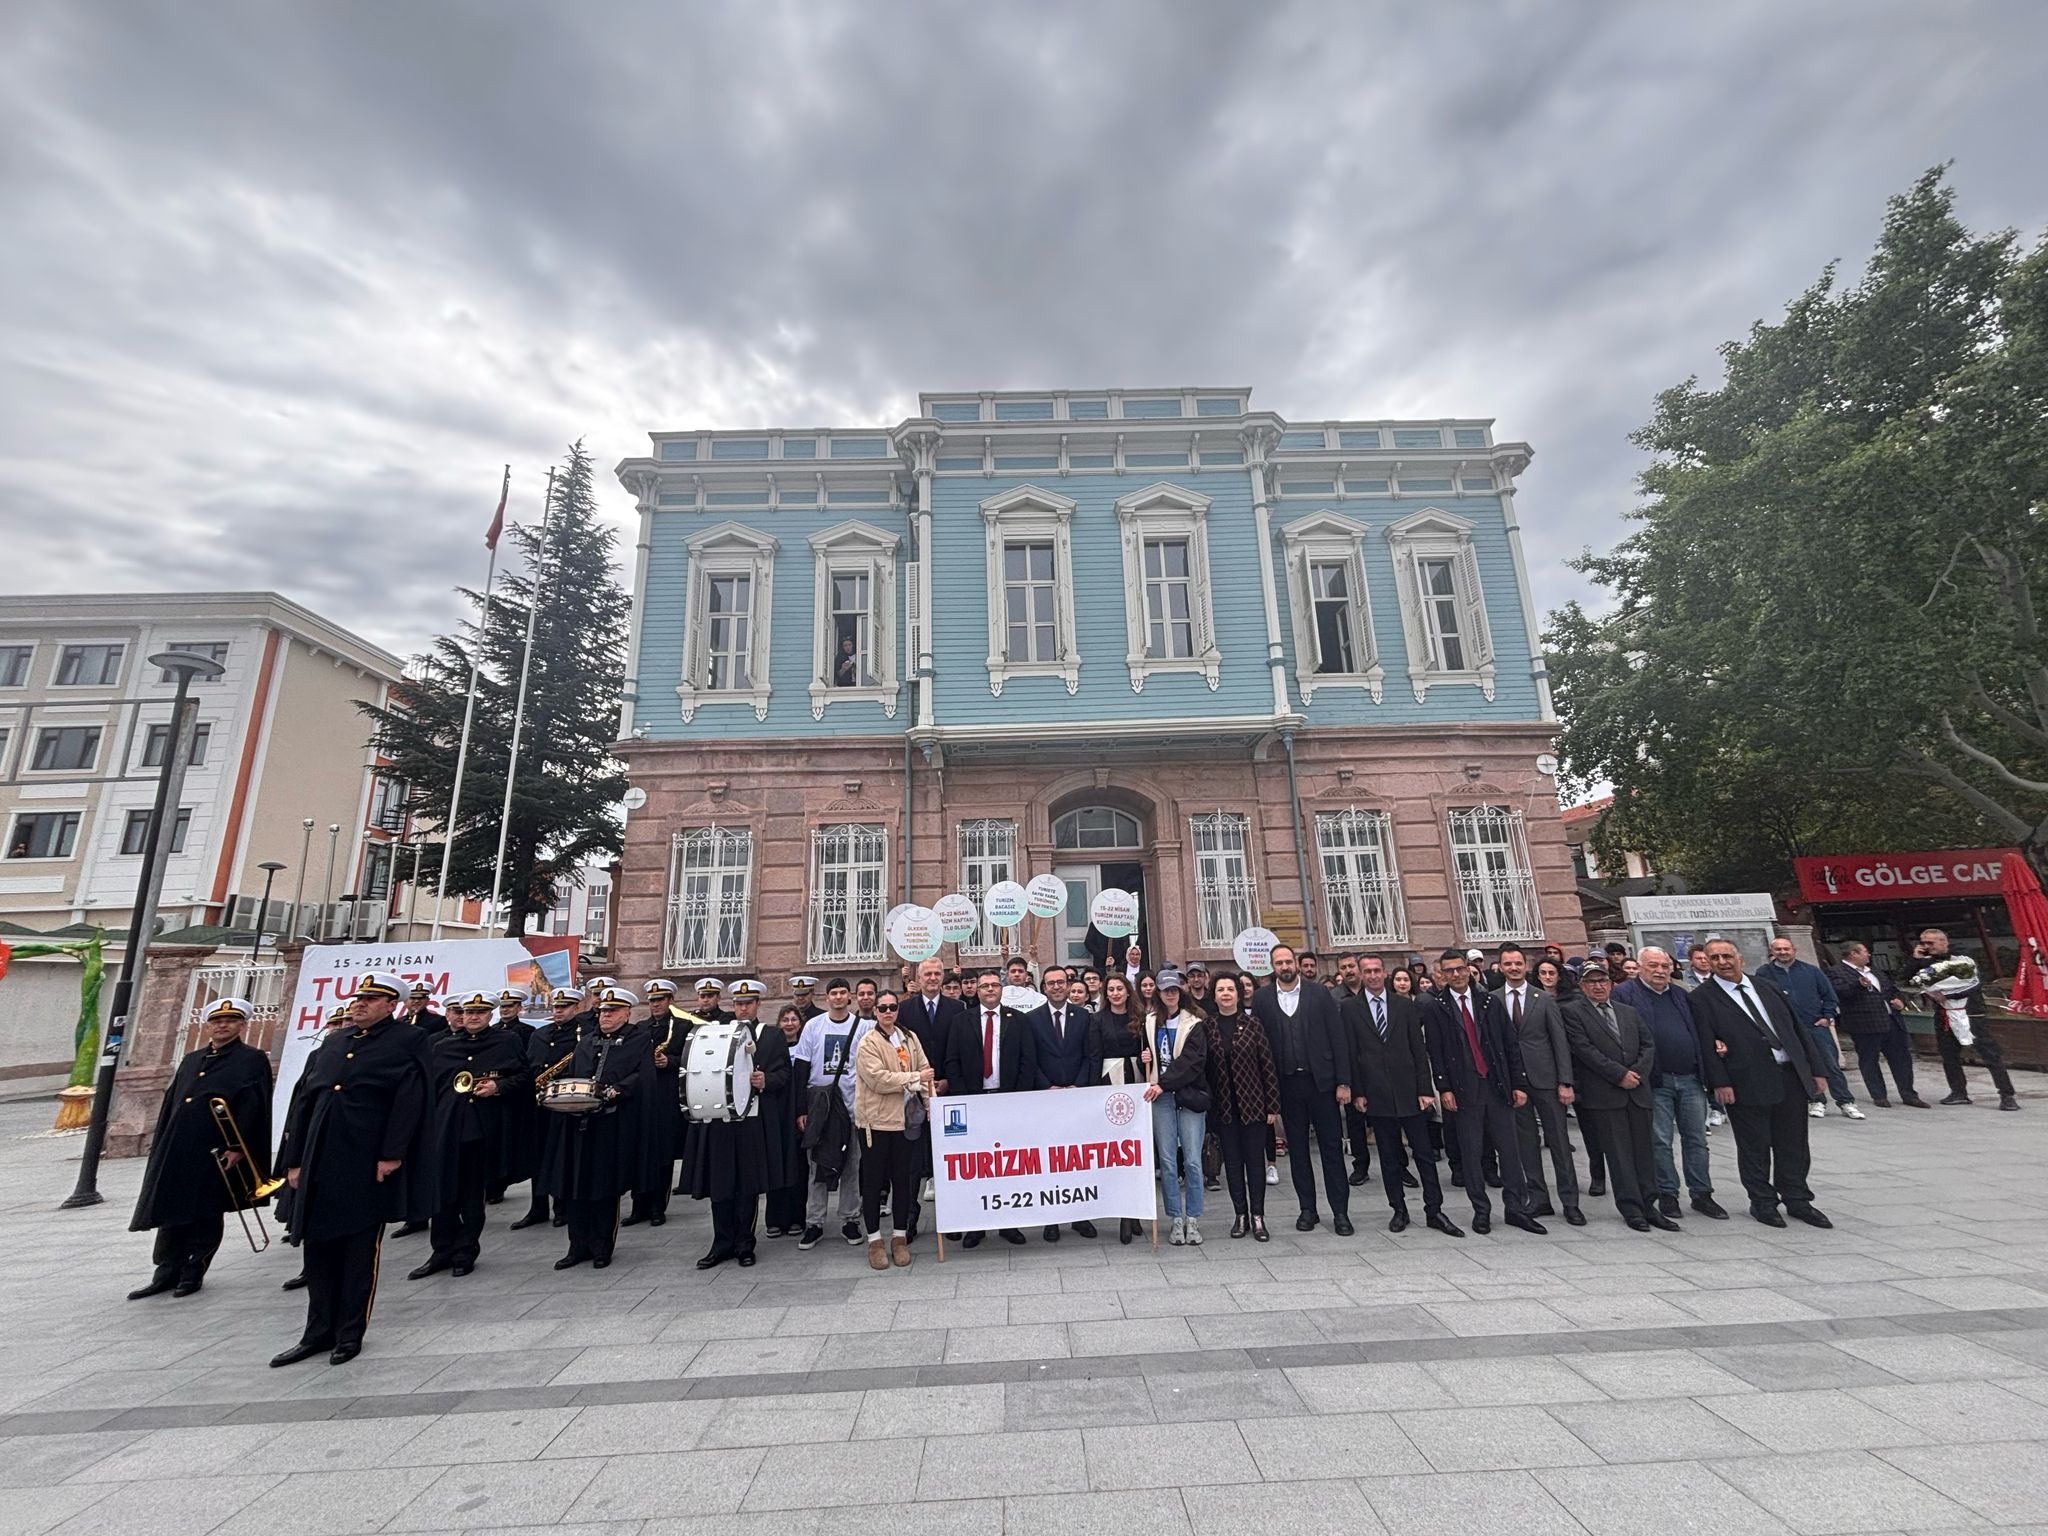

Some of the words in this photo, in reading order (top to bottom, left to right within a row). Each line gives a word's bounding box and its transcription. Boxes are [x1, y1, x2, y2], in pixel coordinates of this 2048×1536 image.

[1855, 862, 1948, 887] GÖLGE
[1952, 862, 2002, 883] CAF
[333, 958, 351, 969] 15
[366, 957, 382, 967] 22
[386, 954, 435, 967] NİSAN
[943, 1142, 1042, 1181] TURİZM
[1048, 1139, 1142, 1174] HAFTASI
[981, 1191, 1034, 1211] 15-22
[1040, 1185, 1099, 1207] NİSAN
